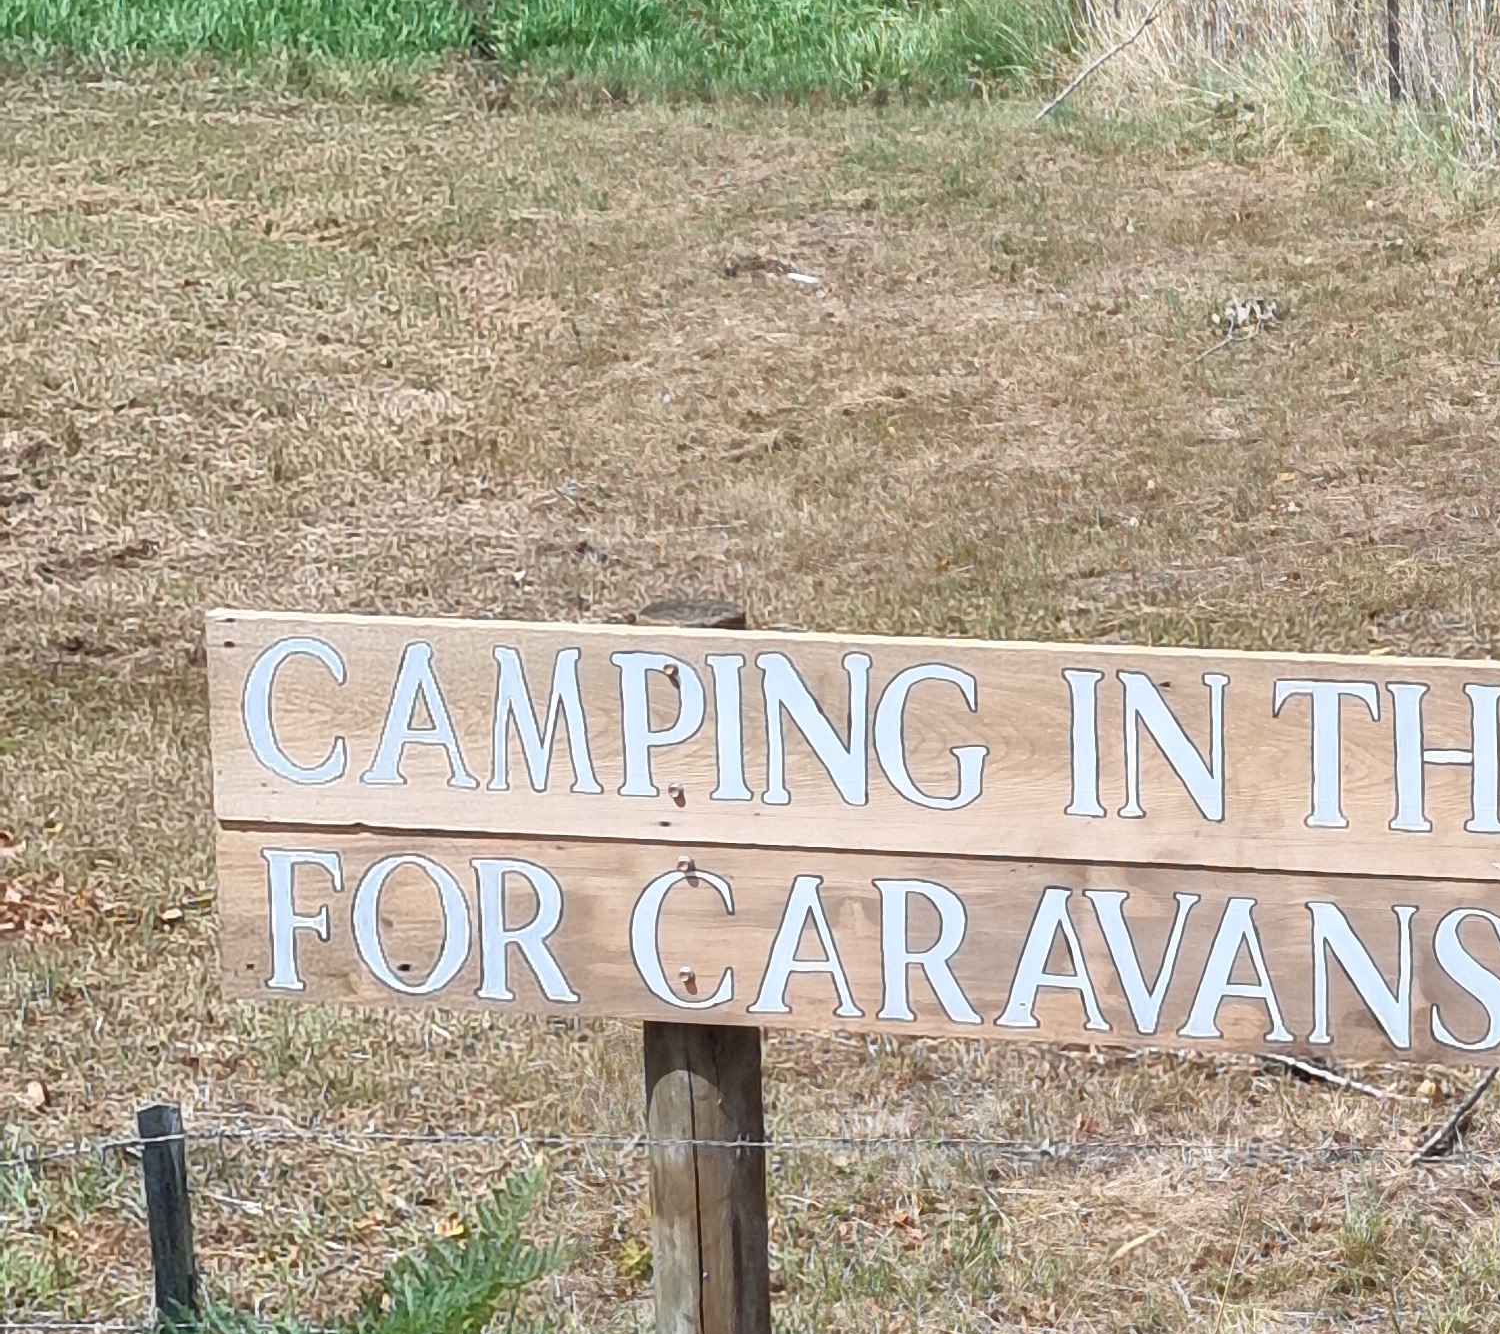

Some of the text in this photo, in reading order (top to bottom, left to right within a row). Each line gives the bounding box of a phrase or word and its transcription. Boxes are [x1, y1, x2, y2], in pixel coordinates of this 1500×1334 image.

[242, 636, 988, 811] CAMPING
[1062, 667, 1230, 822] IN
[261, 846, 581, 1004] FOR
